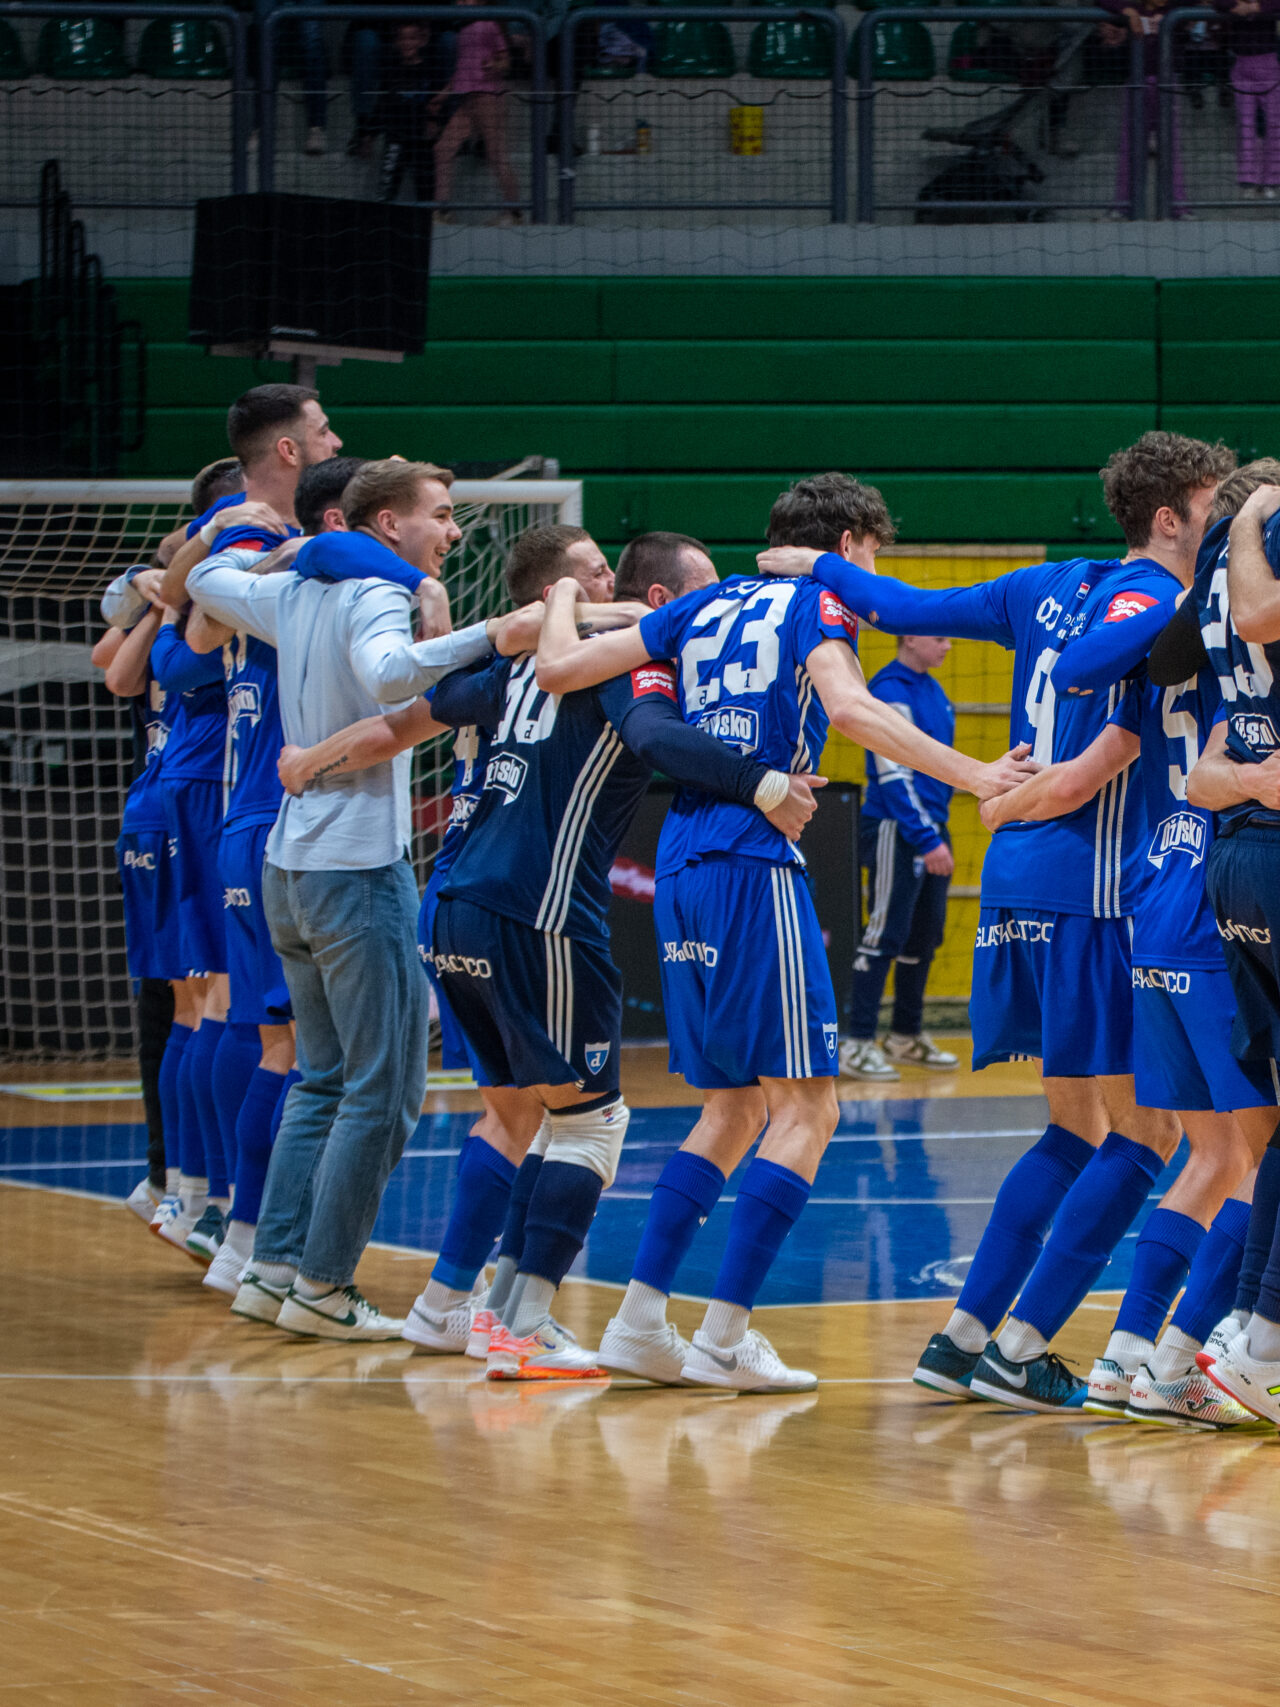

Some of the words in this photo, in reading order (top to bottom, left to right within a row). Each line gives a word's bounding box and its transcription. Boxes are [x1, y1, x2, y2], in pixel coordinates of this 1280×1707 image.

[1113, 599, 1147, 612] Supe
[681, 582, 797, 715] 23
[635, 670, 674, 683] Super
[638, 679, 674, 691] Sport
[590, 1052, 602, 1067] d
